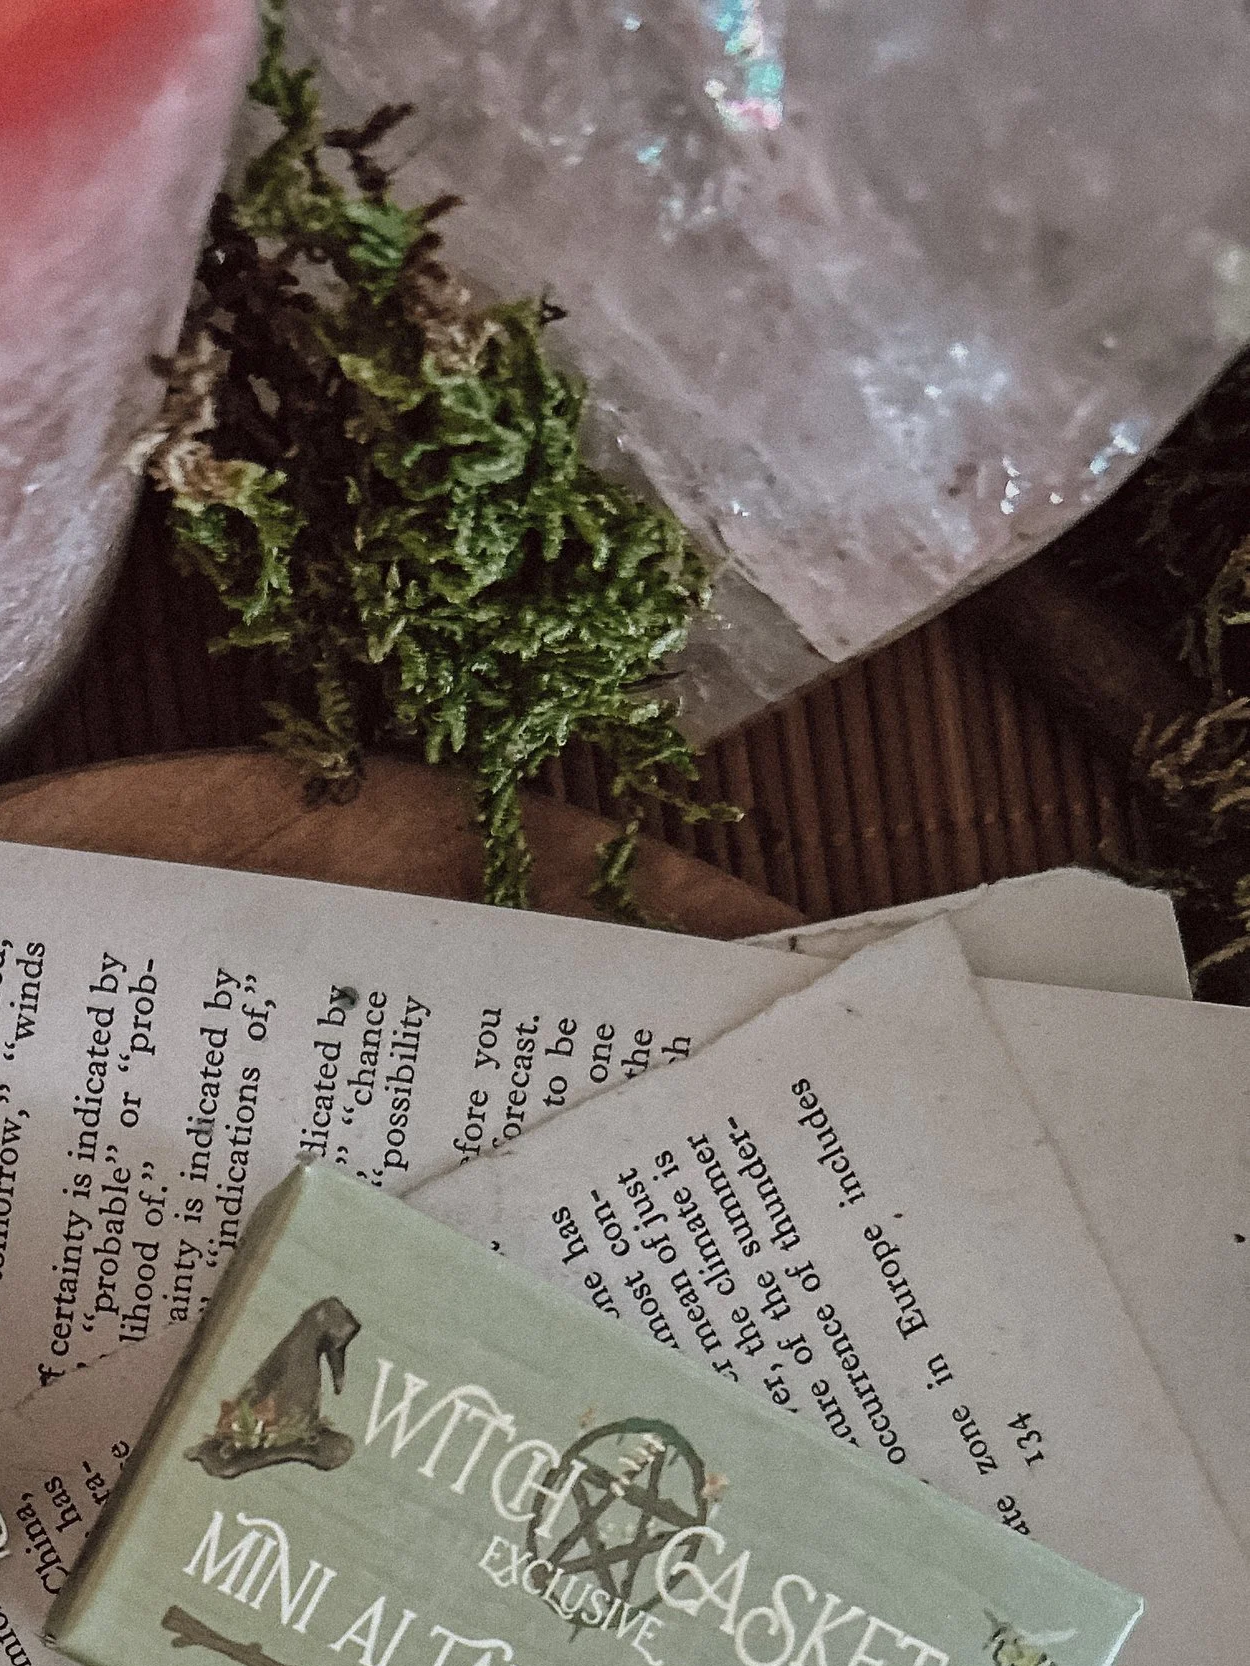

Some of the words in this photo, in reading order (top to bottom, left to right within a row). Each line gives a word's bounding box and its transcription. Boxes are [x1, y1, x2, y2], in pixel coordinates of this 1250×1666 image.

[87, 950, 128, 994] by
[201, 965, 242, 1011] by
[315, 983, 360, 1027] by
[472, 1006, 502, 1071] you
[543, 1016, 578, 1058] be
[588, 1021, 616, 1084] one
[65, 1004, 115, 1163] indicated
[118, 1089, 142, 1129] or
[178, 1025, 229, 1183] indicated
[541, 1074, 568, 1108] to
[651, 1149, 680, 1182] is
[790, 1077, 867, 1209] includes
[61, 1172, 93, 1200] is
[172, 1196, 204, 1224] is
[616, 1166, 669, 1232] just
[685, 1132, 762, 1258] summer
[726, 1114, 801, 1252] thunder-
[550, 1205, 590, 1266] has
[589, 1188, 631, 1257] con-
[638, 1231, 677, 1265] of
[671, 1185, 736, 1296] climate
[49, 1208, 93, 1357] certainty
[755, 1268, 792, 1321] the
[782, 1258, 821, 1293] of
[862, 1222, 929, 1341] Europe
[669, 1267, 723, 1355] mean
[729, 1304, 766, 1357] the
[775, 1331, 814, 1366] of
[925, 1351, 954, 1390] in
[815, 1302, 907, 1465] occurrence
[363, 1357, 603, 1540] WITCH
[950, 1403, 999, 1476] zone
[1005, 1411, 1045, 1467] 134
[42, 1475, 83, 1534] has
[181, 1509, 338, 1634] MINI
[477, 1534, 665, 1666] EXCLUSIVE
